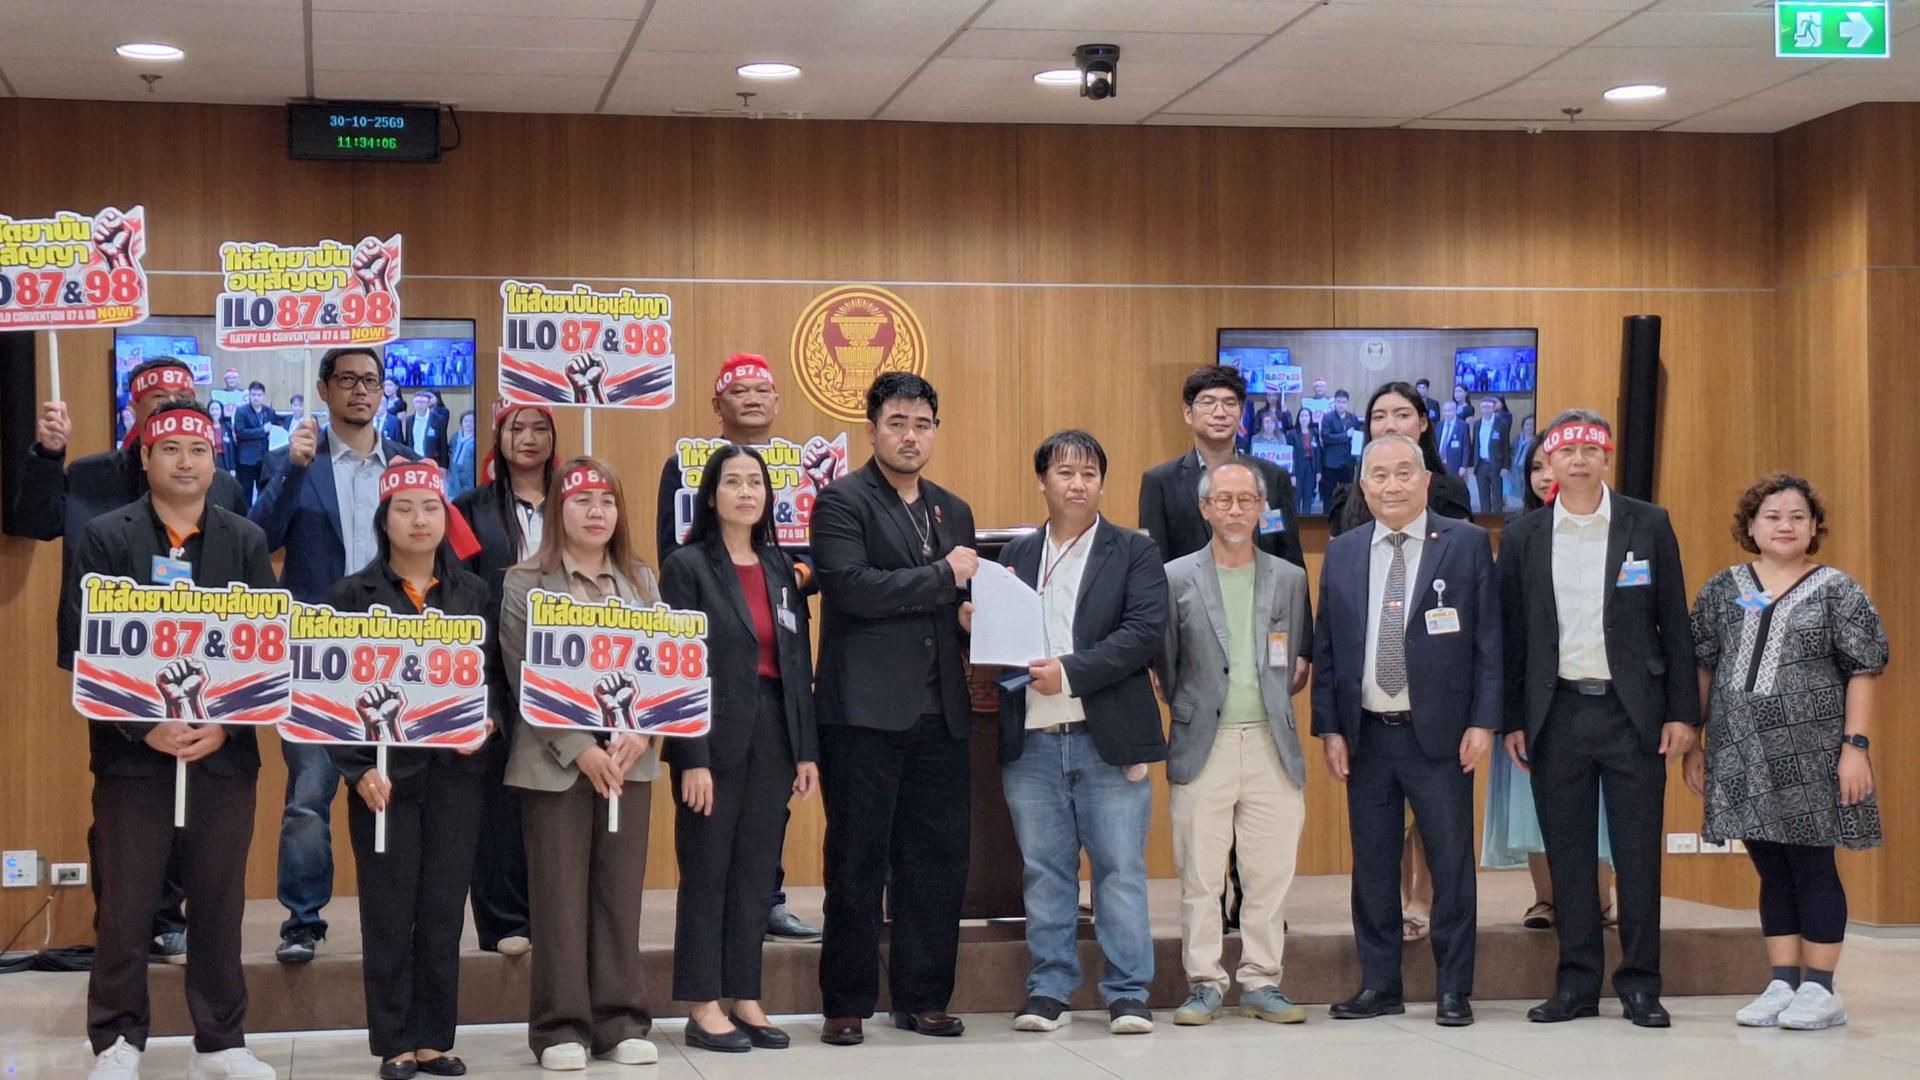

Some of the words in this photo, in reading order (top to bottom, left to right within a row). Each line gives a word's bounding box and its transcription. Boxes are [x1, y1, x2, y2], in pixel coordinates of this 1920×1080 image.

[330, 115, 405, 129] 30-10-2569
[337, 136, 397, 149] 11:34:06
[223, 243, 350, 271] ให้สัตยาบัน
[228, 269, 348, 296] อนุสัญญา
[98, 307, 133, 318] NOW!
[223, 297, 274, 328] ILO
[506, 283, 668, 321] ให้สัตยาบันอนุสัญญา
[351, 327, 385, 339] NOW!
[508, 319, 557, 350] ILO
[137, 372, 158, 391] ILO
[152, 416, 177, 437] ILO
[85, 577, 289, 620] ให้สัตยาบันอนุสัญญา
[290, 604, 482, 646] ให้สัตยาบันอนุสัญญา
[530, 591, 705, 638] ให้สัตยาบันอนุสัญญา
[86, 619, 148, 658] ILO
[532, 631, 585, 667] ILO
[290, 645, 347, 680] ILO
